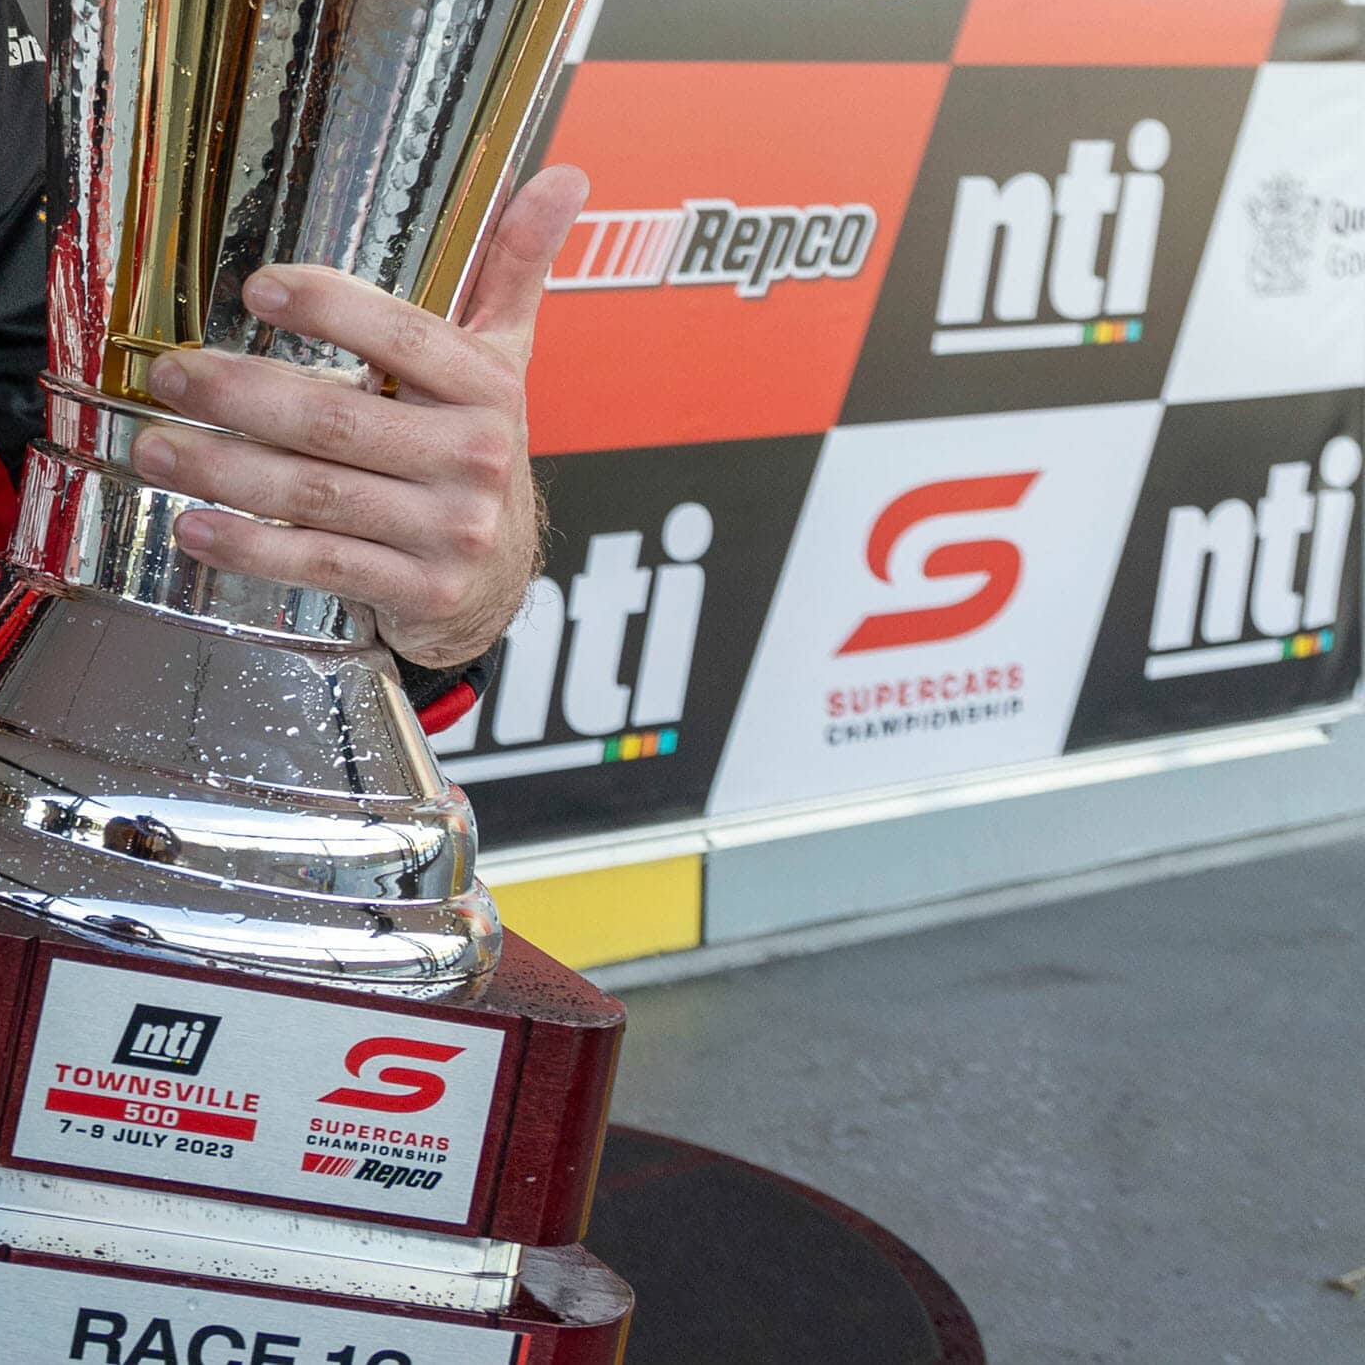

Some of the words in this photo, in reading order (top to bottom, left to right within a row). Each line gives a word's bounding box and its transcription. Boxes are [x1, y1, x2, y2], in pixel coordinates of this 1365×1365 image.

[936, 119, 1171, 326] nti
[671, 202, 875, 295] Repco
[1149, 435, 1364, 652] nti
[826, 665, 1024, 719] SUPERCARS
[823, 696, 1024, 747] CHAMPIONSHIP
[131, 1020, 206, 1060] nti
[55, 1063, 261, 1114] TOWNSVILLE
[123, 1103, 180, 1127] 500
[309, 1117, 451, 1152] SUPERCARS
[112, 1127, 169, 1149] JULY
[174, 1137, 235, 1160] 2023
[306, 1134, 448, 1165] CHAMPIONSHIP
[352, 1158, 444, 1191] Repco
[68, 1306, 301, 1365] RACE
